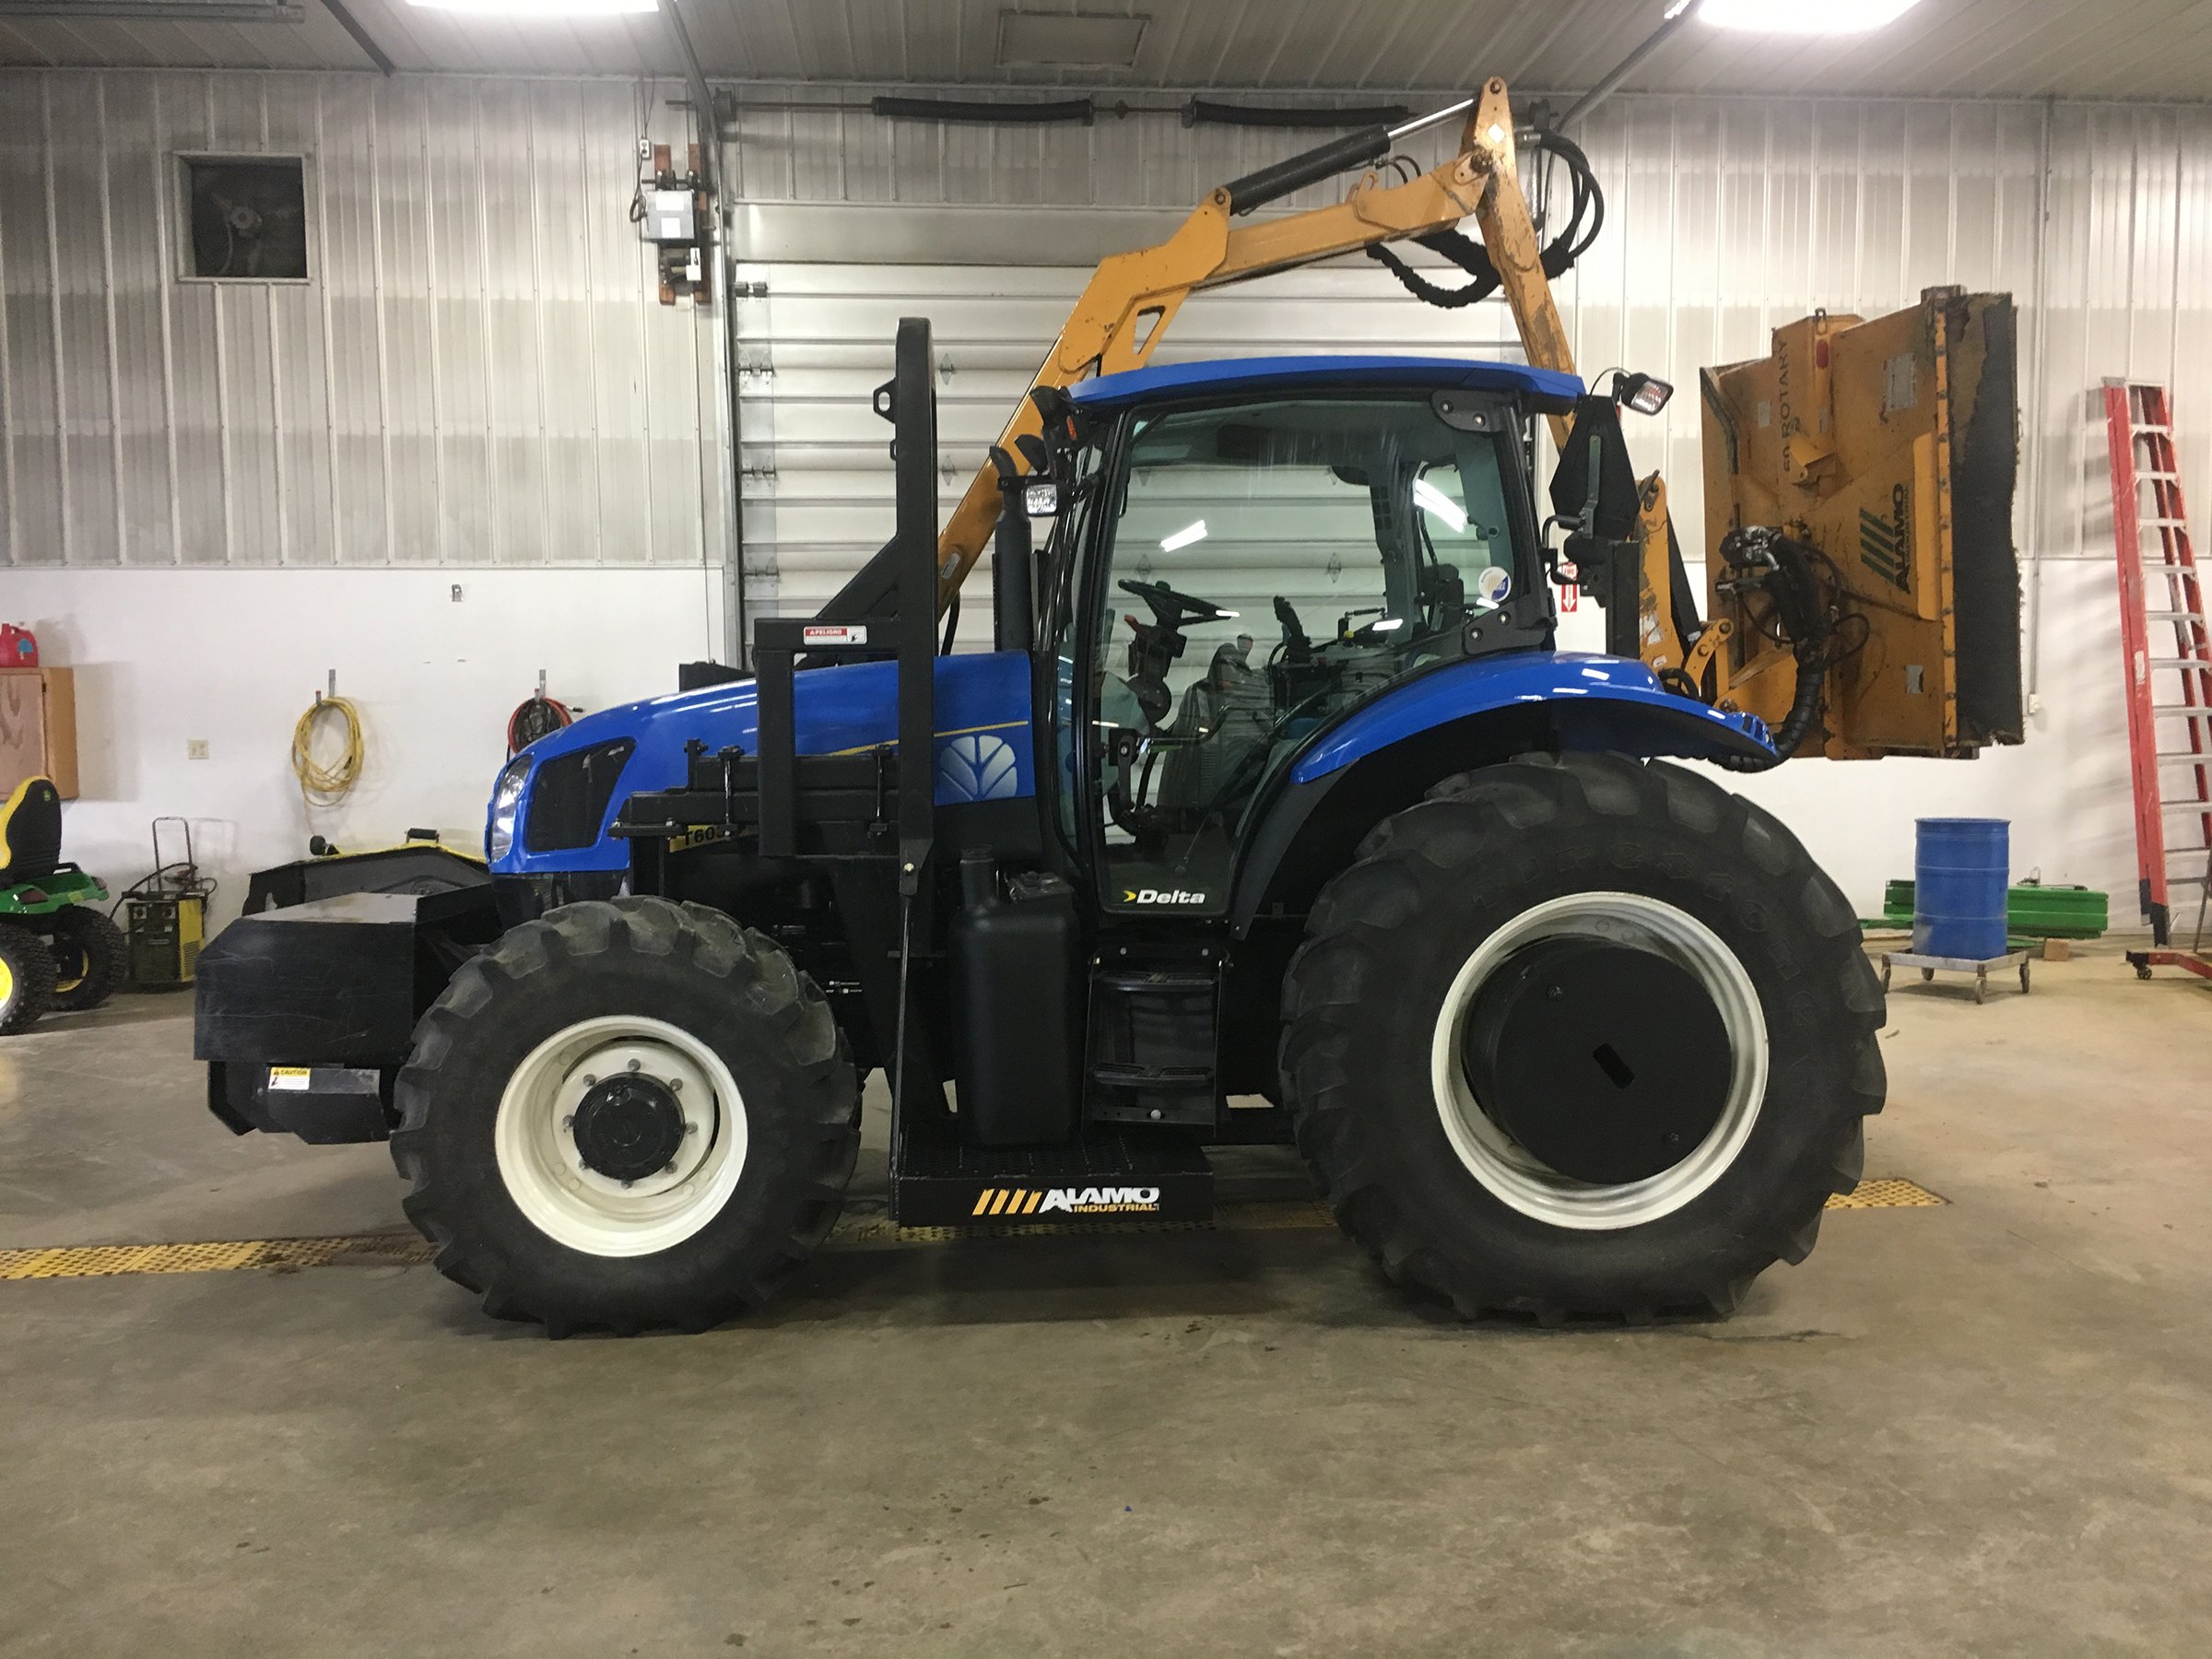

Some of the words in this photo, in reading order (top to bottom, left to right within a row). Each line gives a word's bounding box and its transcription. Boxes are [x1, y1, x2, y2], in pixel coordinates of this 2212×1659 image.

[1778, 340, 1791, 439] ROTARY
[1892, 484, 1911, 594] ALAMO
[1136, 889, 1206, 904] Delta
[1039, 1187, 1159, 1214] ALAMO
[1074, 1203, 1157, 1213] INDUSTRIAL
